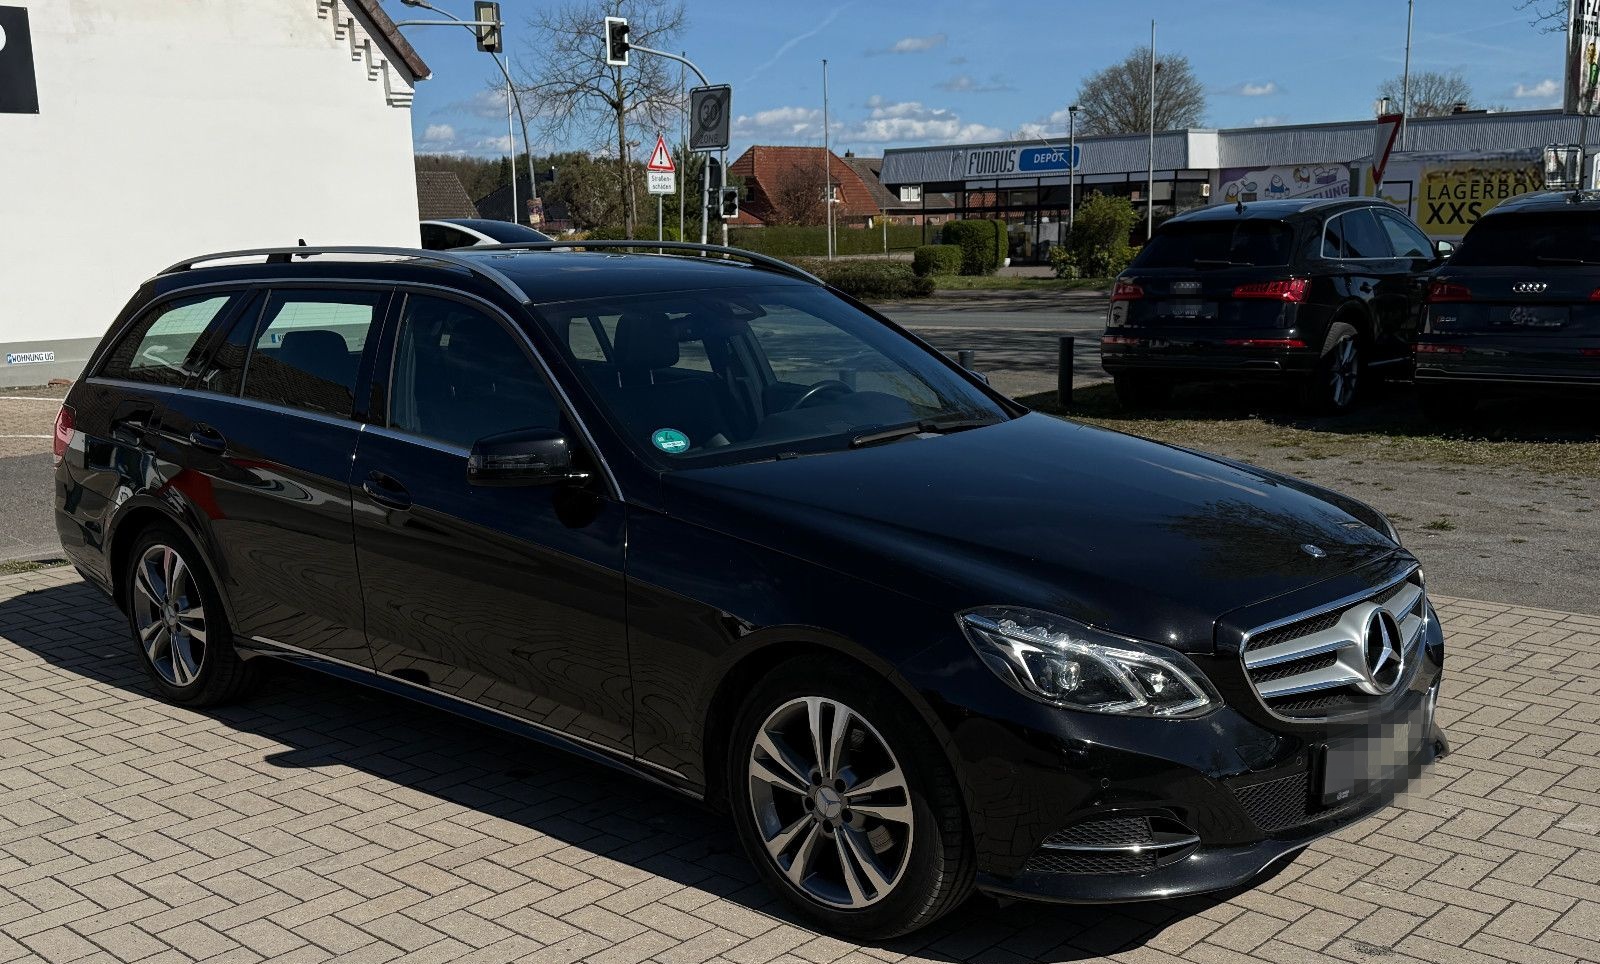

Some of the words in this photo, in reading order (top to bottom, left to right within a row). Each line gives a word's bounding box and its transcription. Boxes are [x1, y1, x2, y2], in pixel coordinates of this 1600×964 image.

[968, 149, 1017, 175] FUNDUS
[1033, 152, 1065, 164] DEPOT
[1426, 202, 1482, 224] XXS
[12, 353, 44, 363] WOHNUNG
[44, 352, 54, 361] UG
